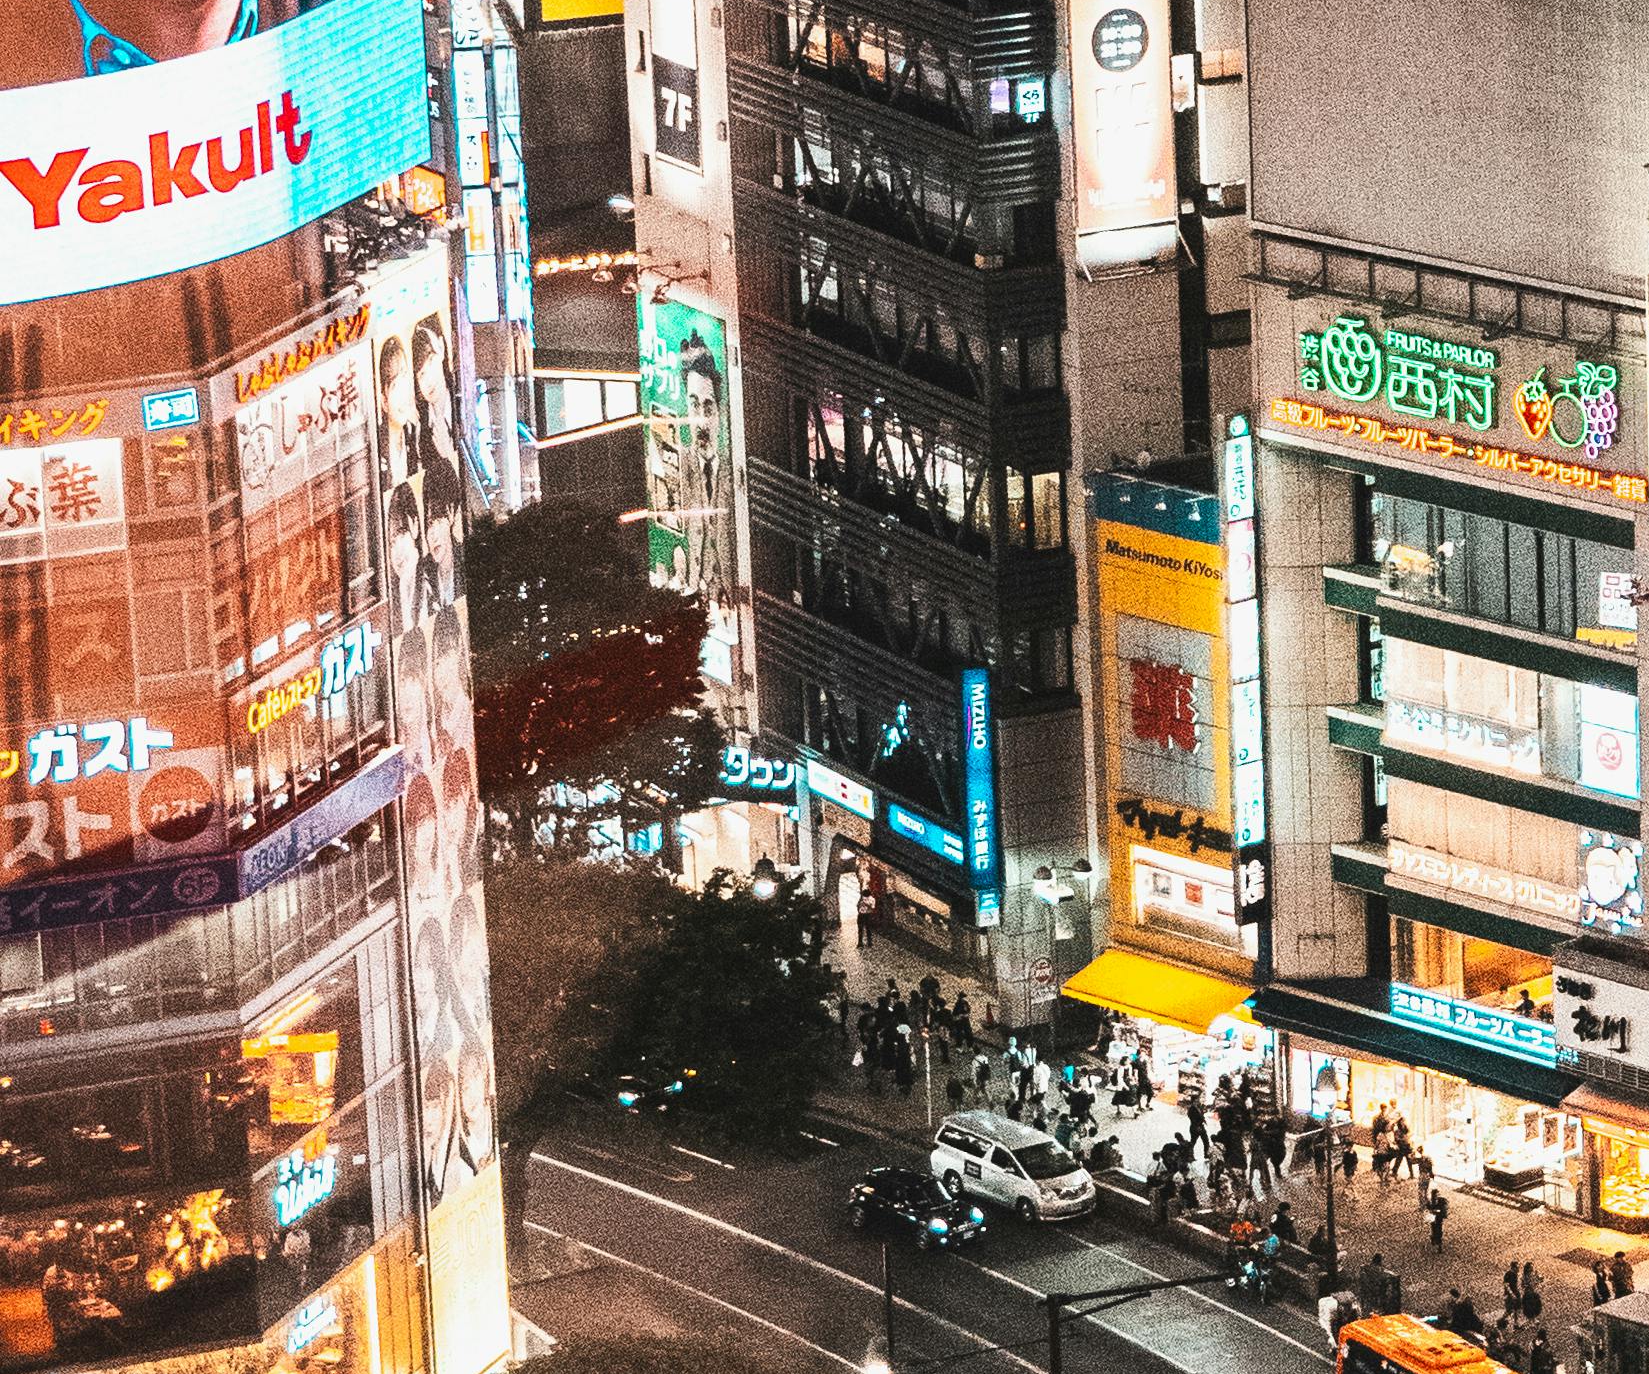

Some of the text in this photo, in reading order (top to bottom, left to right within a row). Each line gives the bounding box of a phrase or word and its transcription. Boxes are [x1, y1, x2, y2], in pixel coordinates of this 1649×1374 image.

[661, 88, 692, 132] 7F
[1, 90, 312, 228] Yakult
[1301, 332, 1320, 391] 渋谷
[1387, 355, 1495, 432] 西村
[1105, 538, 1182, 571] Matsumoto
[321, 621, 383, 697] ガスト
[971, 683, 987, 750] MIZUHO
[28, 717, 174, 785] ガスト
